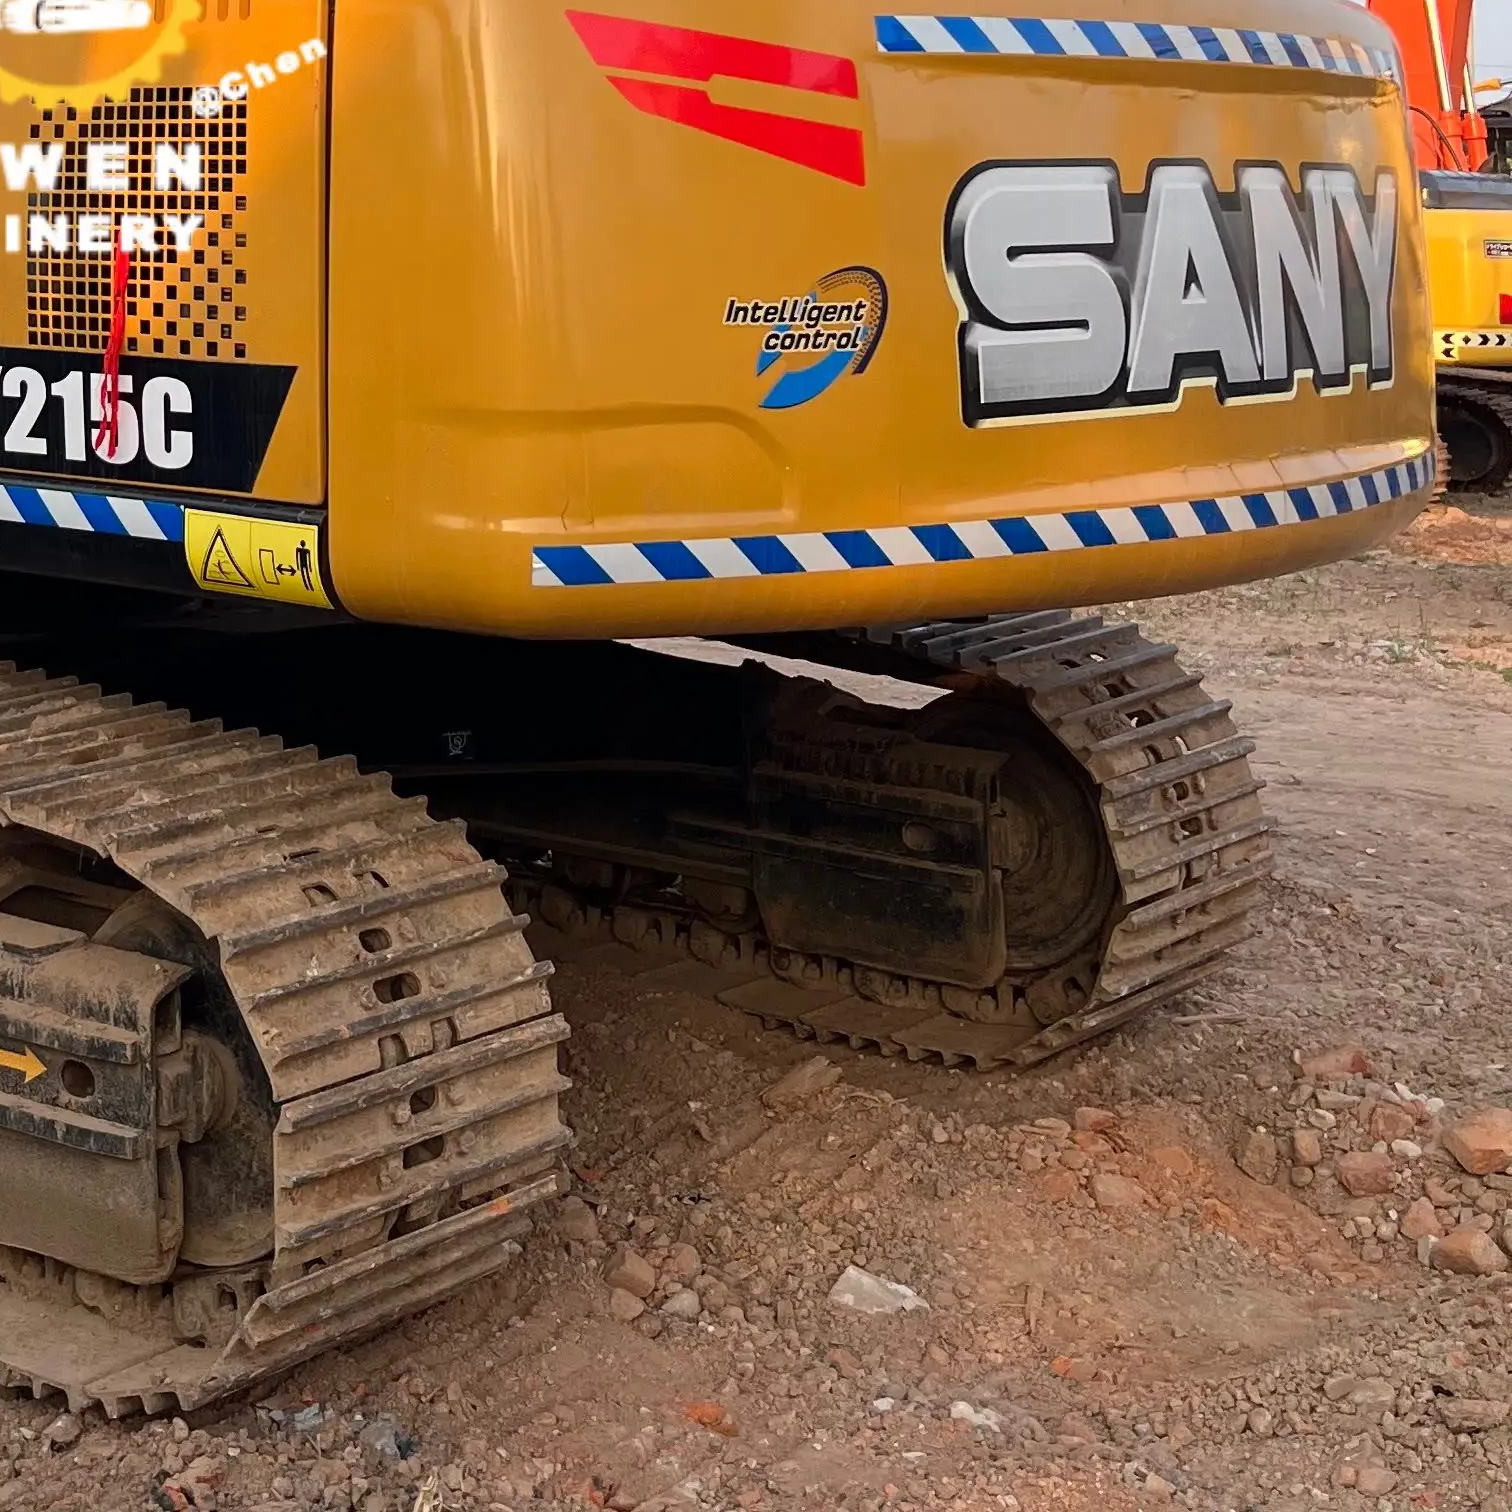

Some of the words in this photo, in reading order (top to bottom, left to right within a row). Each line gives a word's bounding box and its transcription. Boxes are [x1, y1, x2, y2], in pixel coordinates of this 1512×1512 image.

[954, 162, 1397, 410] SANY
[724, 298, 868, 329] Intelligent
[763, 326, 862, 351] control
